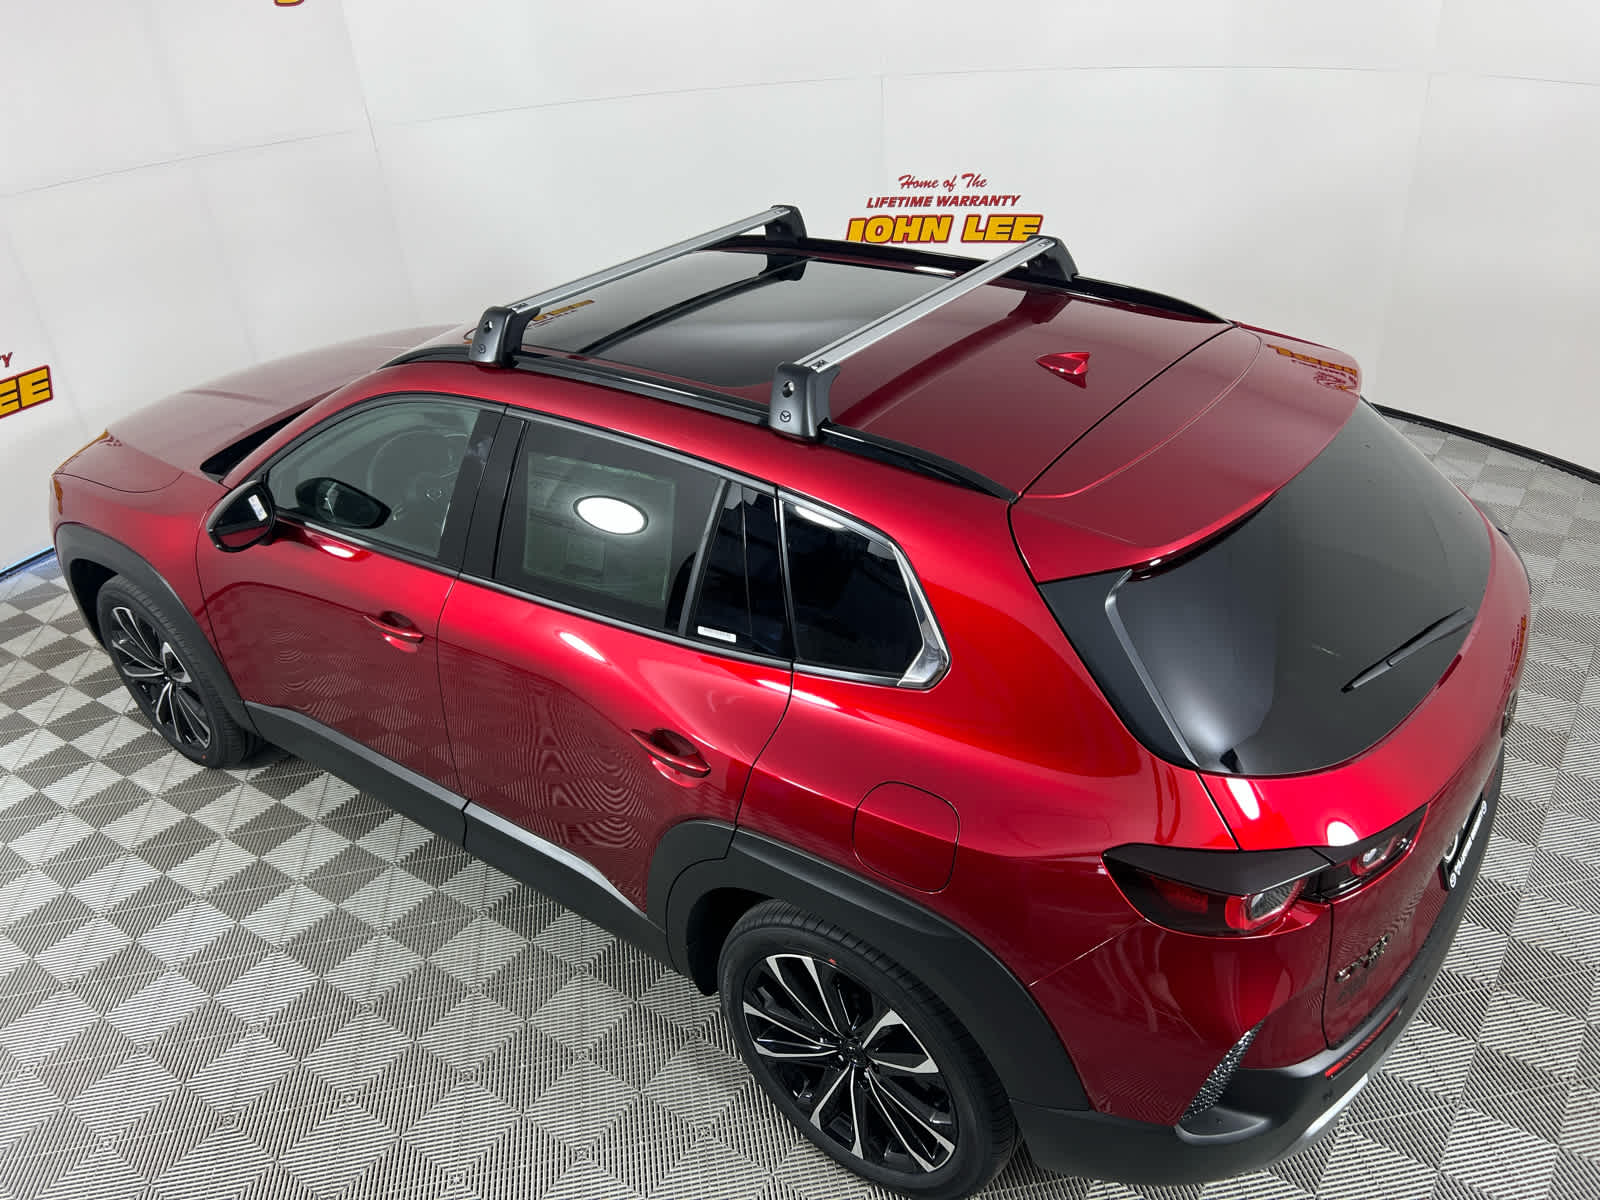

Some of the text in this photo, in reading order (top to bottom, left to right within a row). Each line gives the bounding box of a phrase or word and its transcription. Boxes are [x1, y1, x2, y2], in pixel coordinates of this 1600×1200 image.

[898, 173, 987, 192] Home of The
[866, 194, 1021, 208] LIFETIME WARRANTY
[961, 214, 1043, 243] LEE
